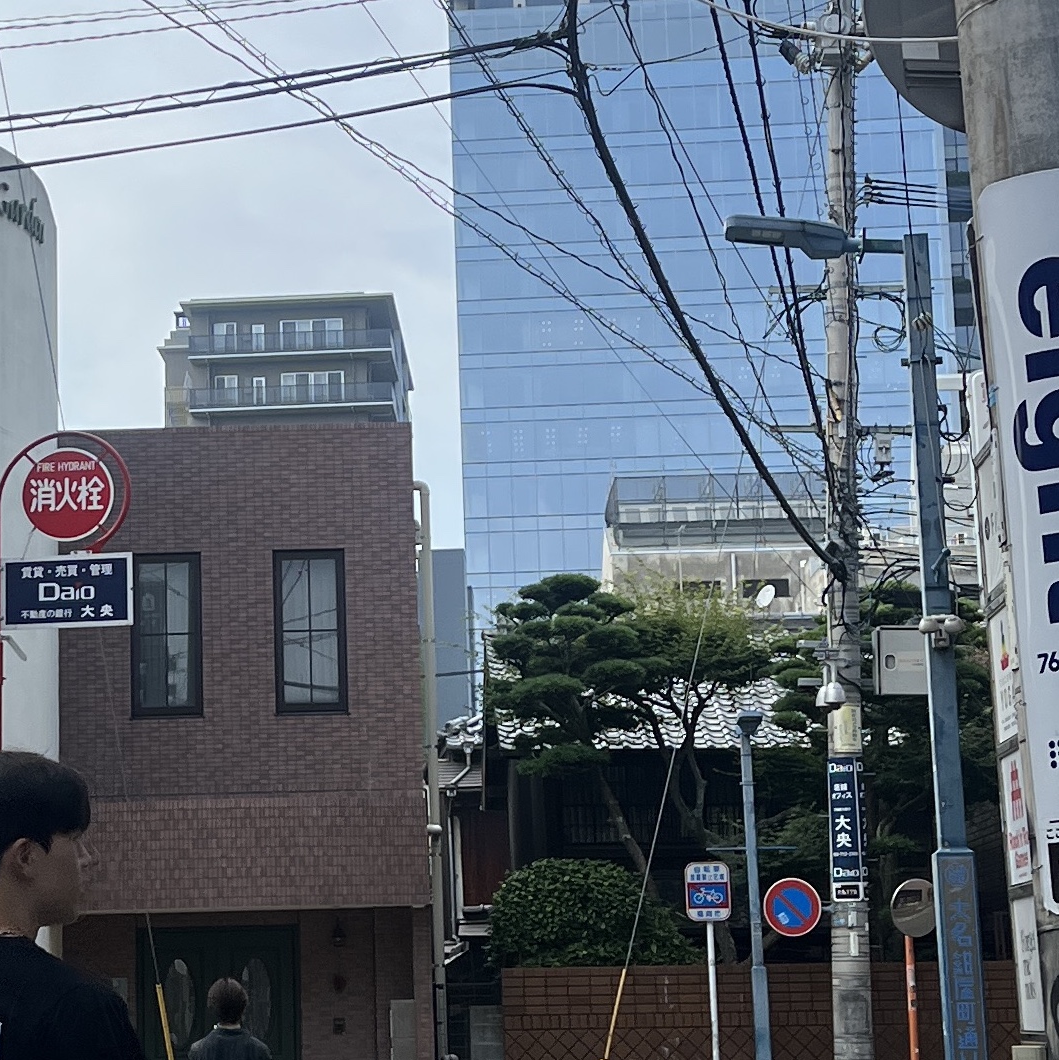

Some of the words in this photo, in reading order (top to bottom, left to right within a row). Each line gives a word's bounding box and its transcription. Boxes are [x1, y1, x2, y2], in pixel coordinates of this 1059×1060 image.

[36, 462, 56, 473] FIRE
[57, 460, 96, 472] HYDRANT
[29, 476, 105, 513] 消火栓
[38, 582, 95, 602] Daio
